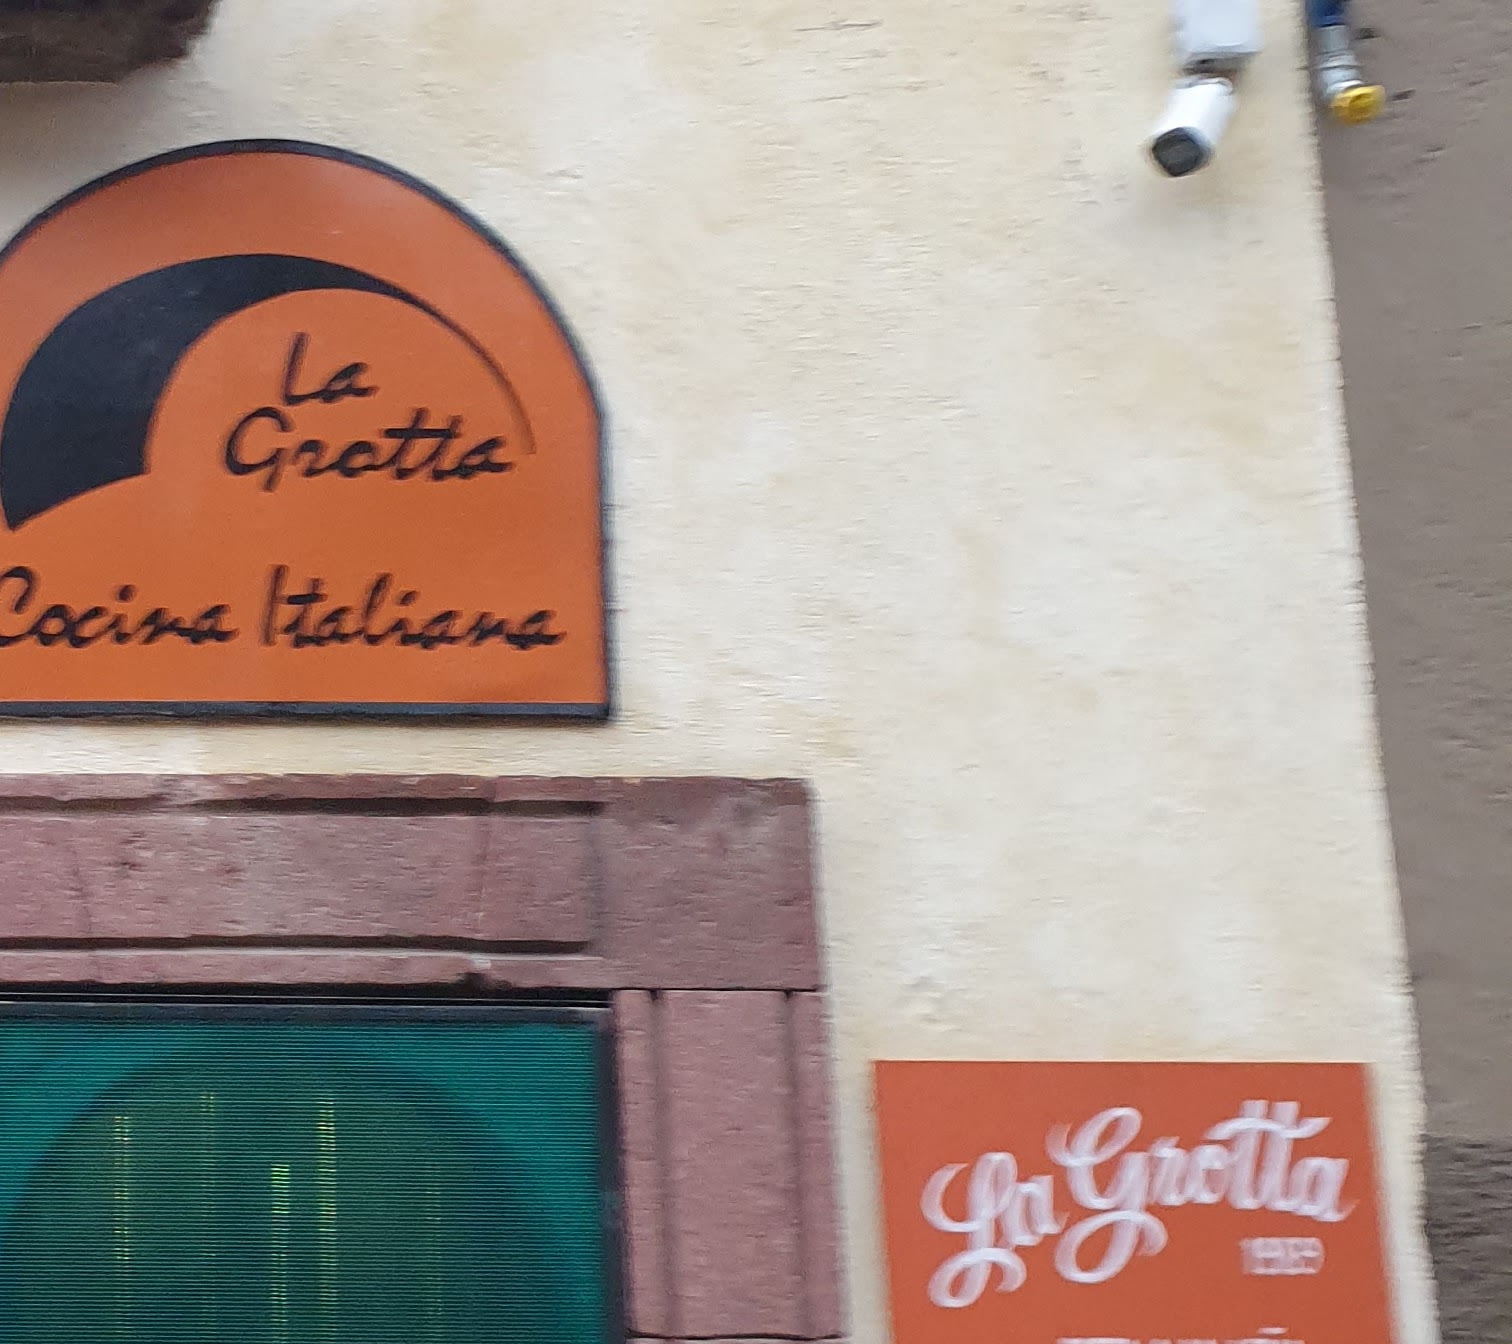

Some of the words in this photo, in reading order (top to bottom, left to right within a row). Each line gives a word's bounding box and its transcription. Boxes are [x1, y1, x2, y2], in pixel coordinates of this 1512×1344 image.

[280, 331, 378, 407] La
[222, 407, 515, 492] Grotta
[257, 563, 568, 650] Italiana
[919, 1150, 1069, 1308] La
[1045, 1099, 1360, 1284] Grotta
